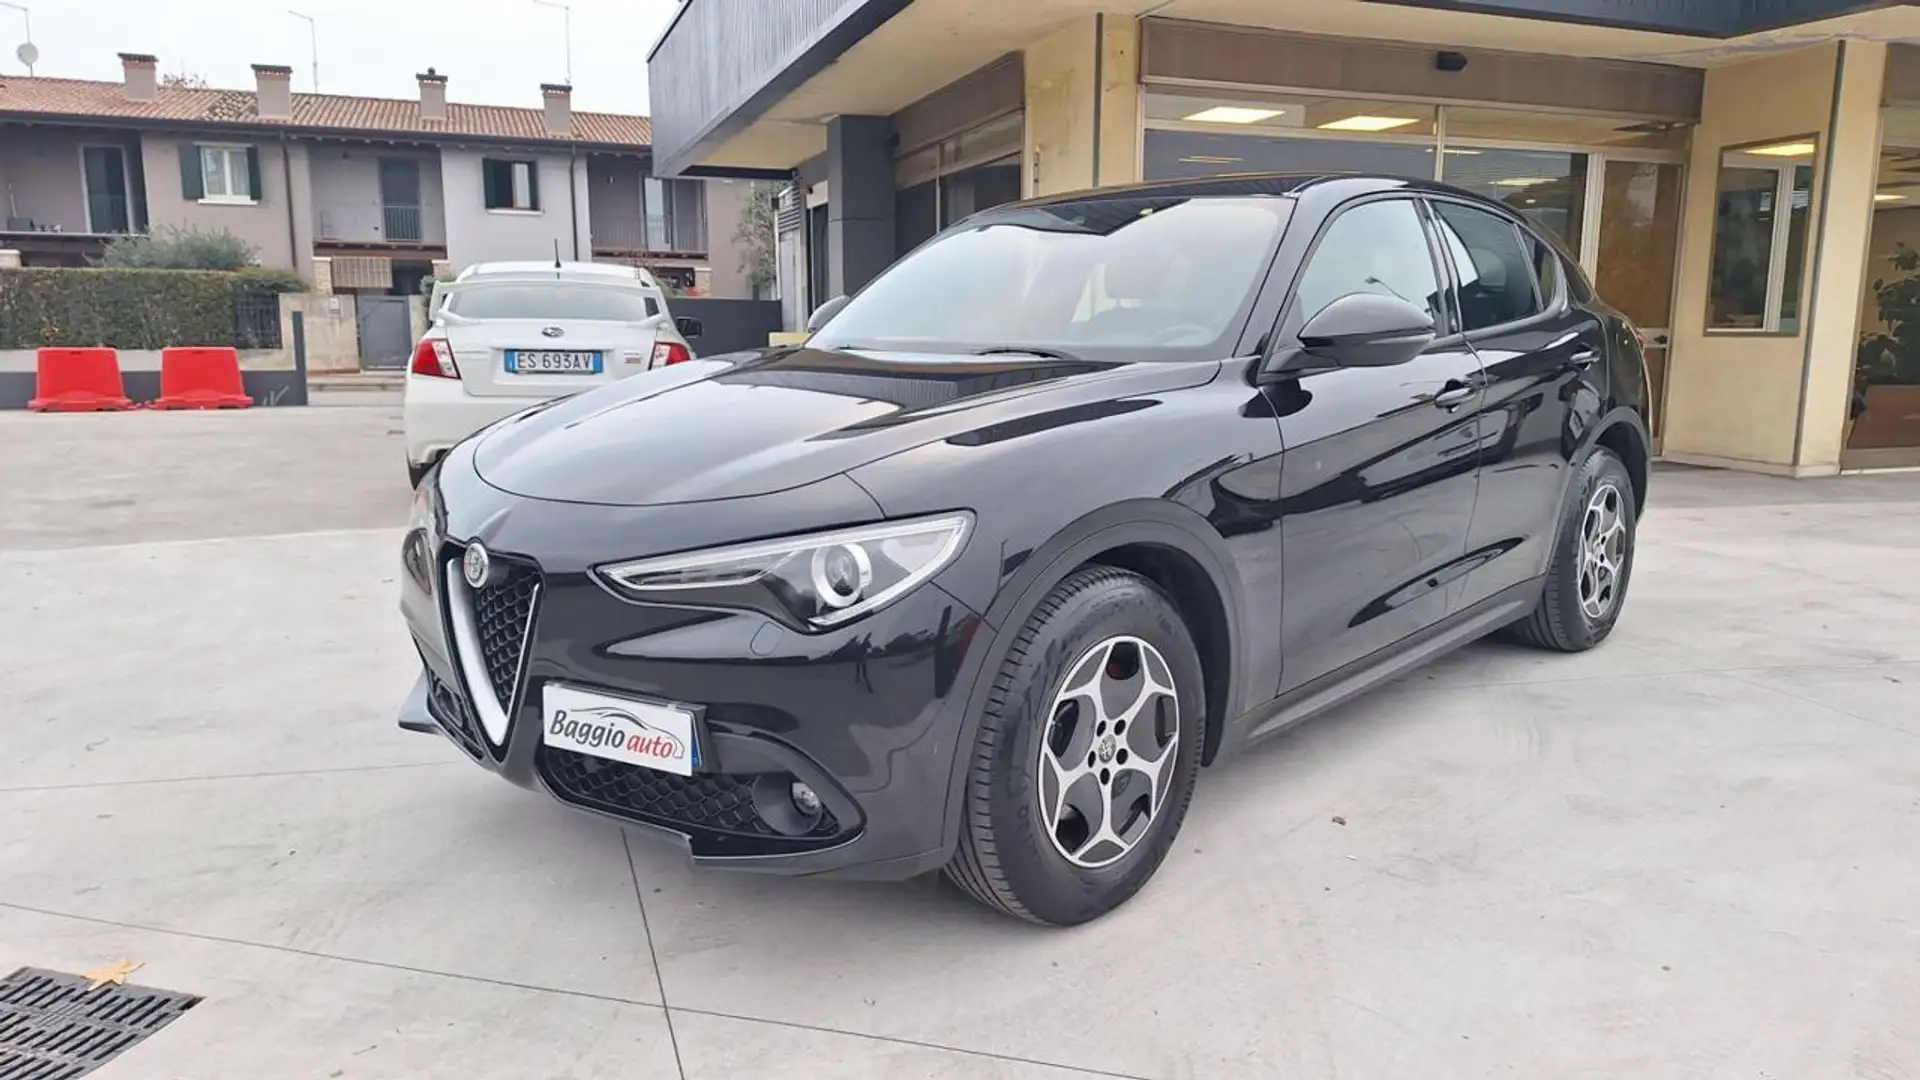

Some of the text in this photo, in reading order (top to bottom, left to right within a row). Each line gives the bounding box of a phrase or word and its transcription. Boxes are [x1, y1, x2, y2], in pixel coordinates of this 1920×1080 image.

[517, 353, 592, 369] ES 693AV
[549, 709, 673, 759] Baggio auto
